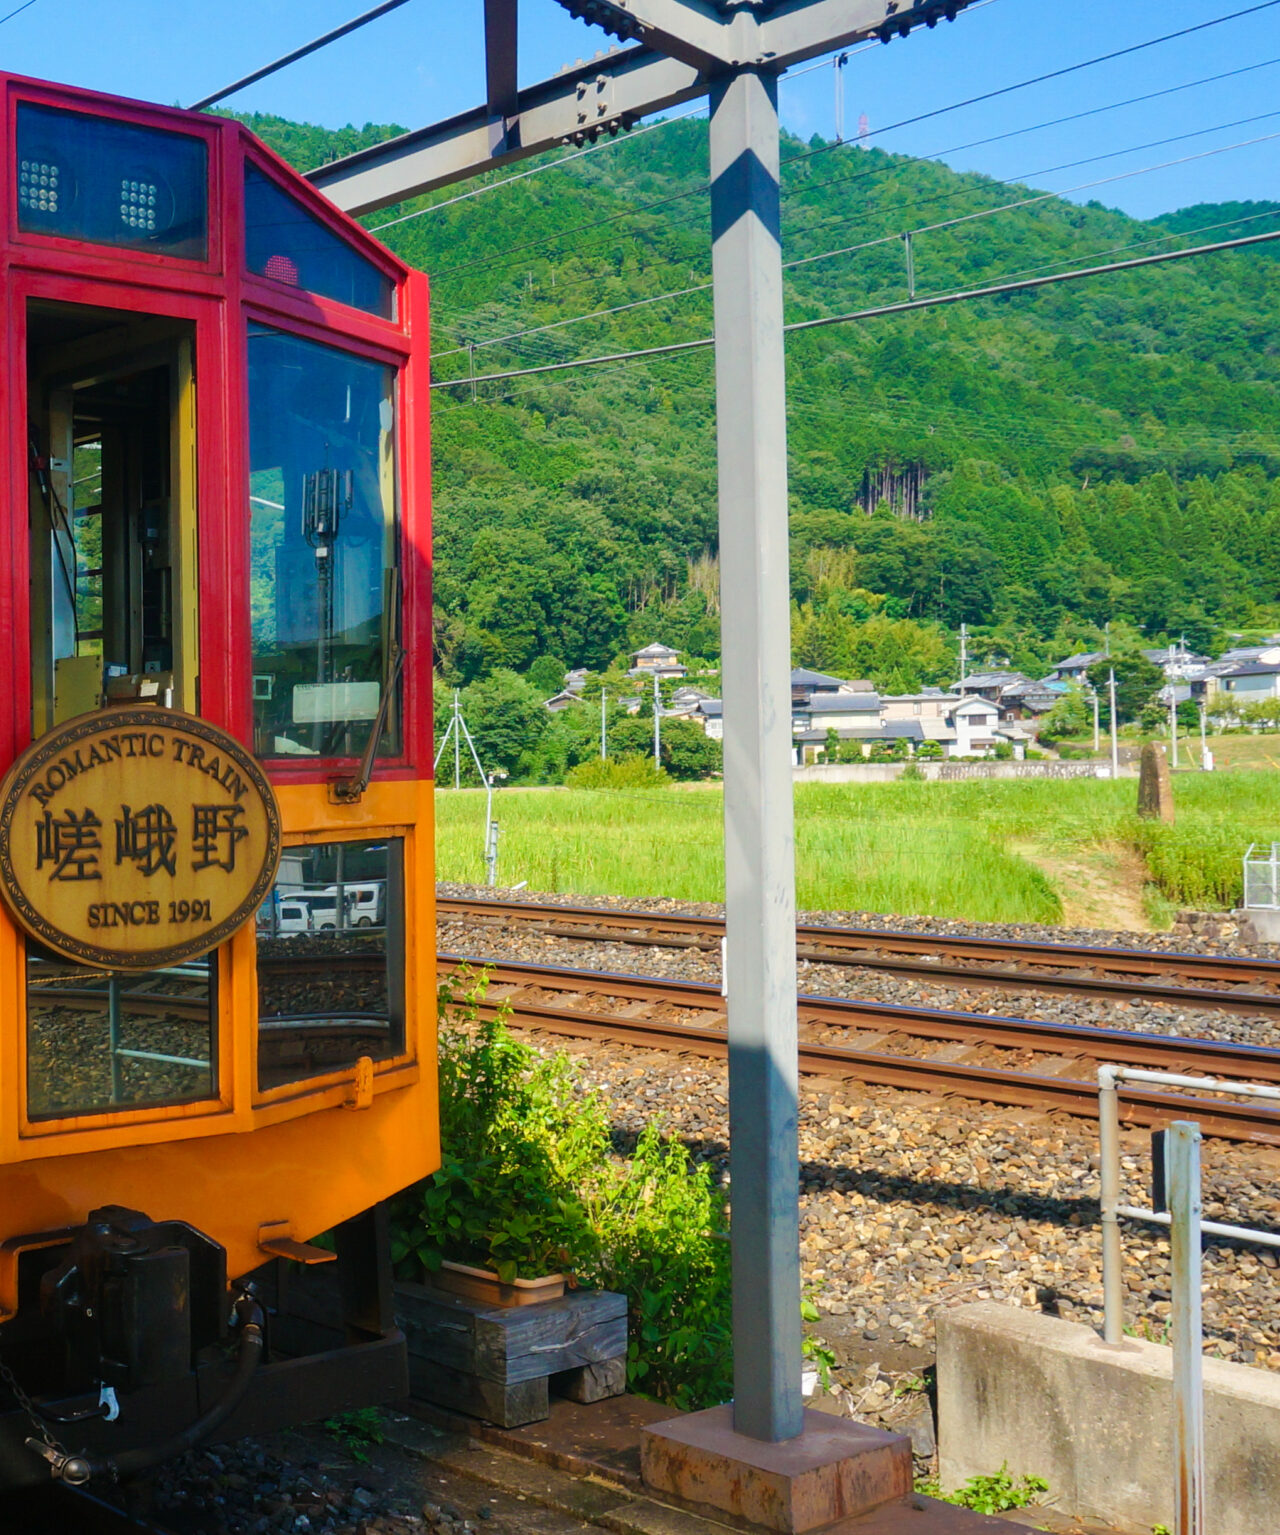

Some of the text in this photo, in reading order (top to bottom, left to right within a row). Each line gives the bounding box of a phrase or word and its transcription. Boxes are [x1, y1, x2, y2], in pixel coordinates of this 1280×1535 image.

[28, 732, 249, 808] ROMANTIC TRAIN
[35, 803, 249, 882] 嵯峨野
[87, 899, 211, 929] SINCE 1991
